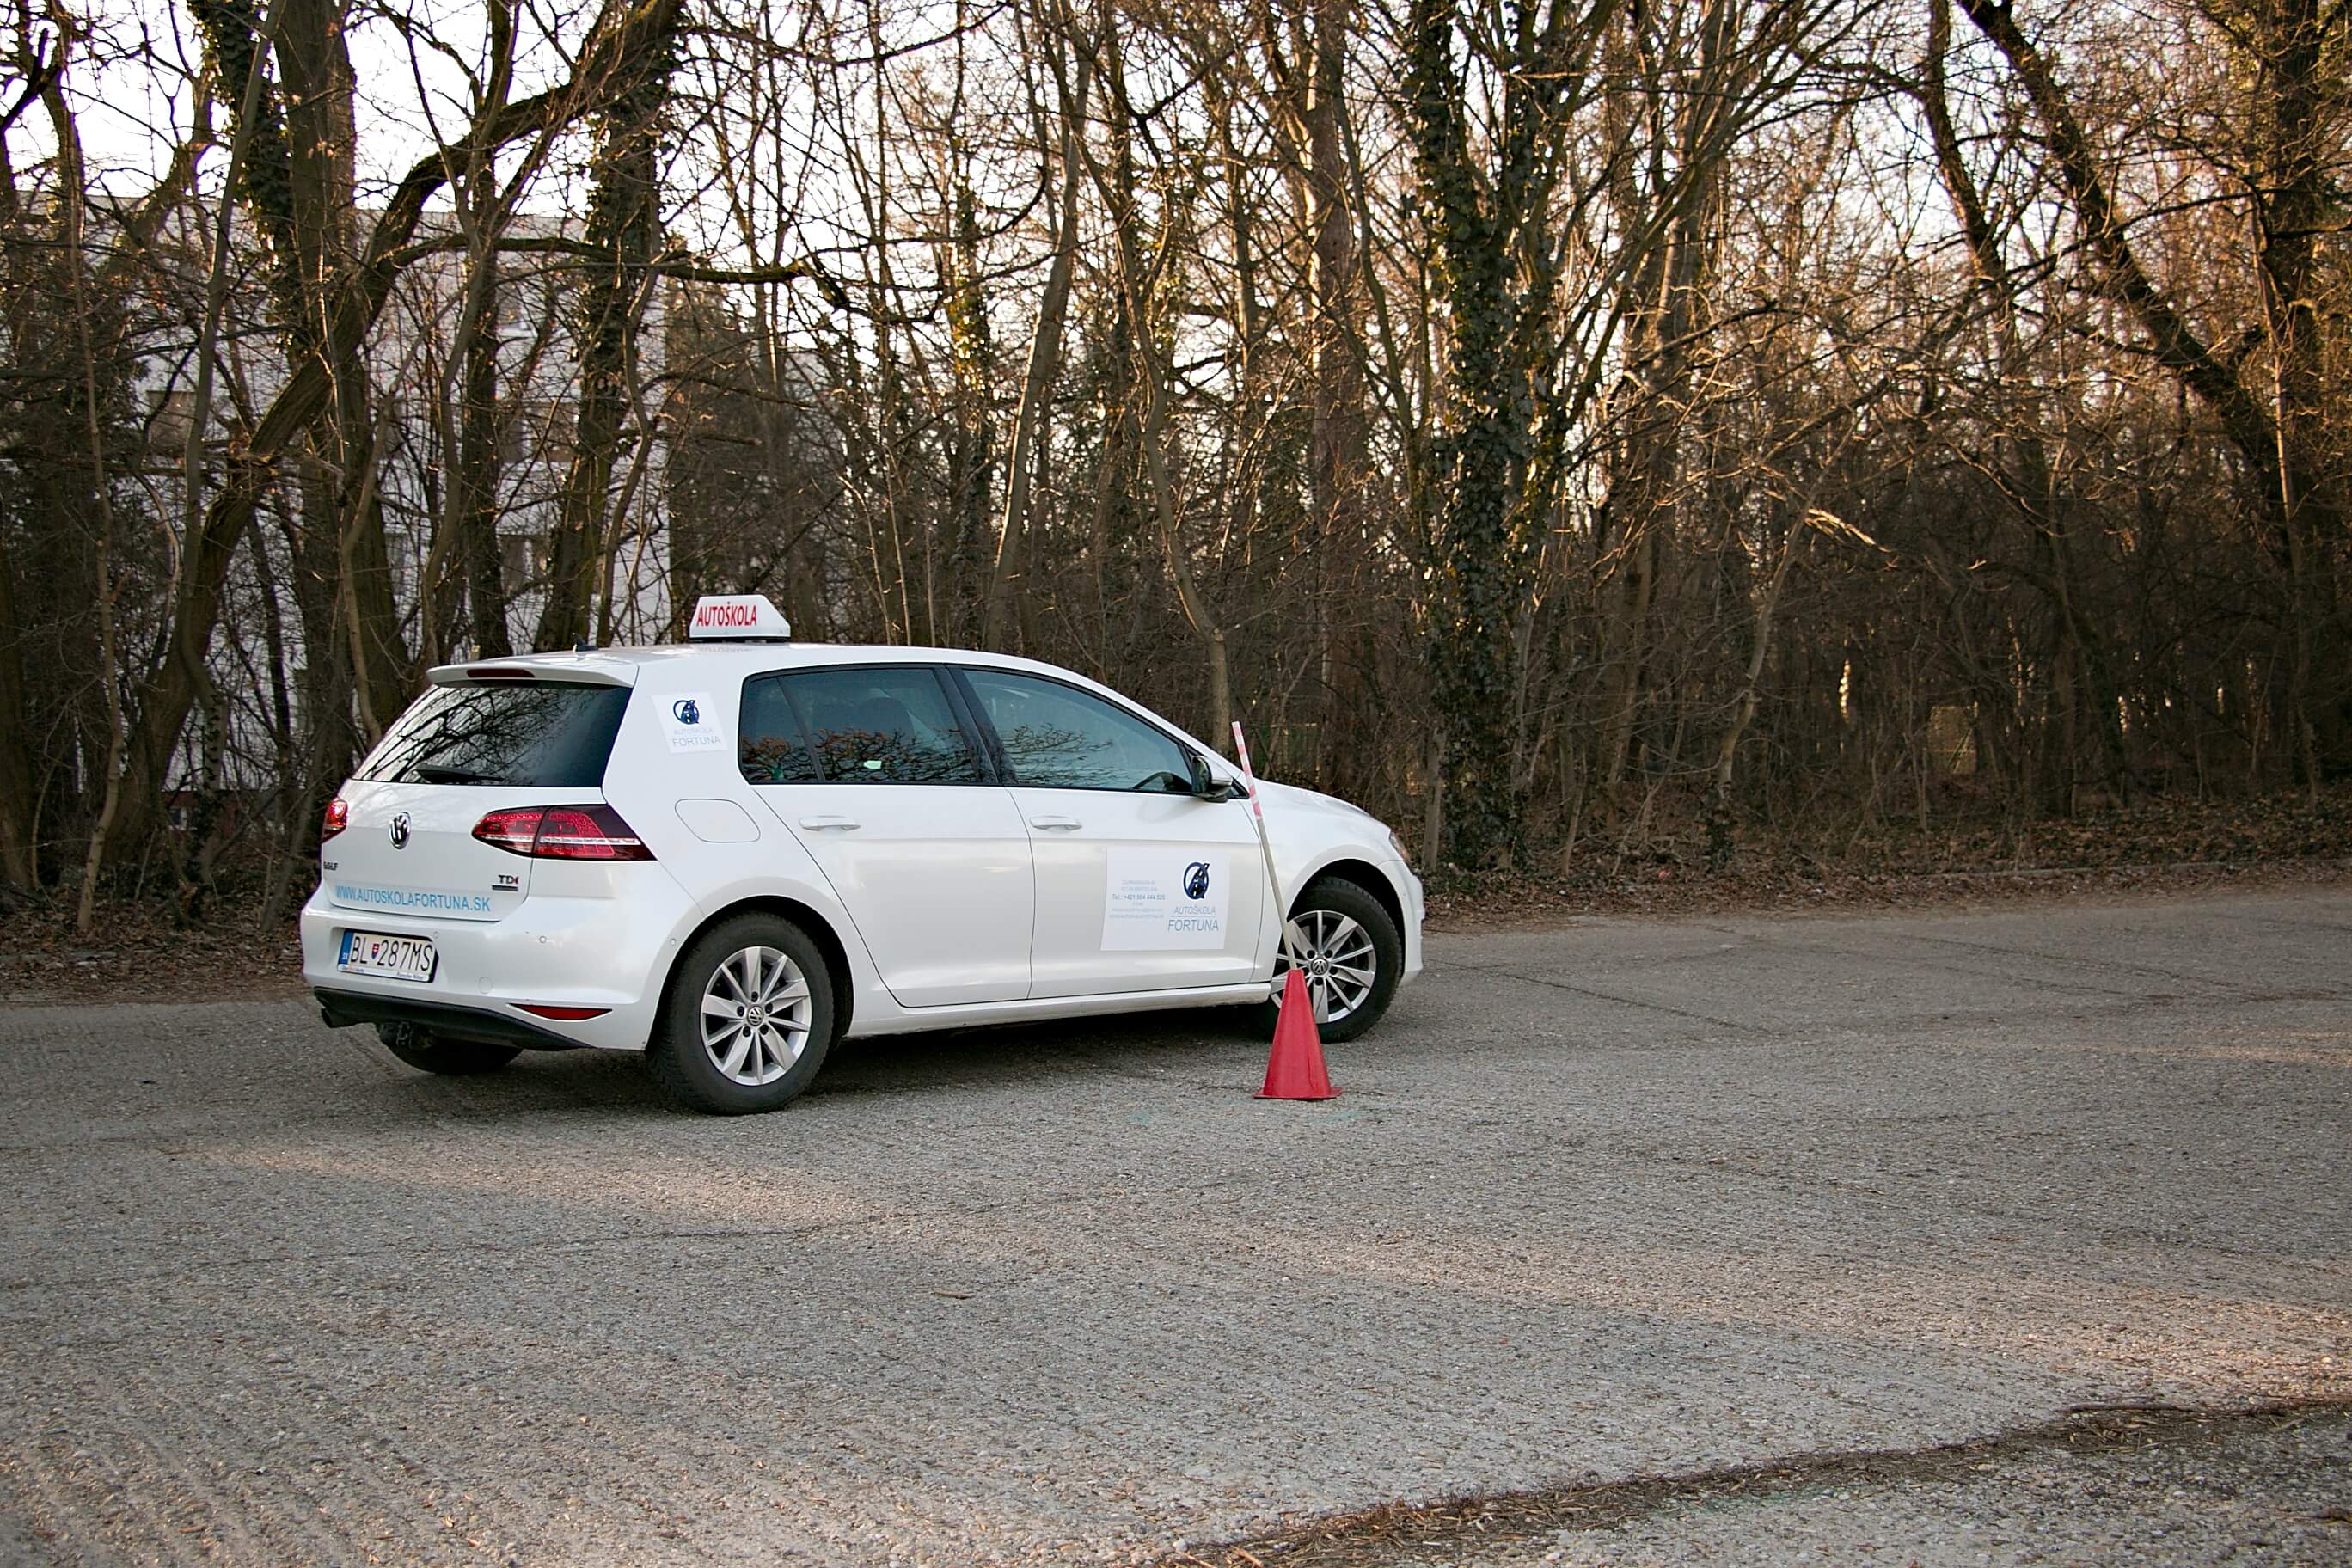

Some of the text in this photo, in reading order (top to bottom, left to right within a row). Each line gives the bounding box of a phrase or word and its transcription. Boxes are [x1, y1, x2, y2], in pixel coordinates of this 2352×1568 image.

[696, 602, 756, 626] AUTOŠKOLA
[672, 736, 721, 746] FORTUNA
[335, 885, 491, 911] WWW.AUTOSKOLAFORTUNA.SK
[1175, 905, 1216, 915] AUTOŠKOLA
[1167, 919, 1219, 931] FORTUNA
[351, 936, 432, 971] BL 287MS
